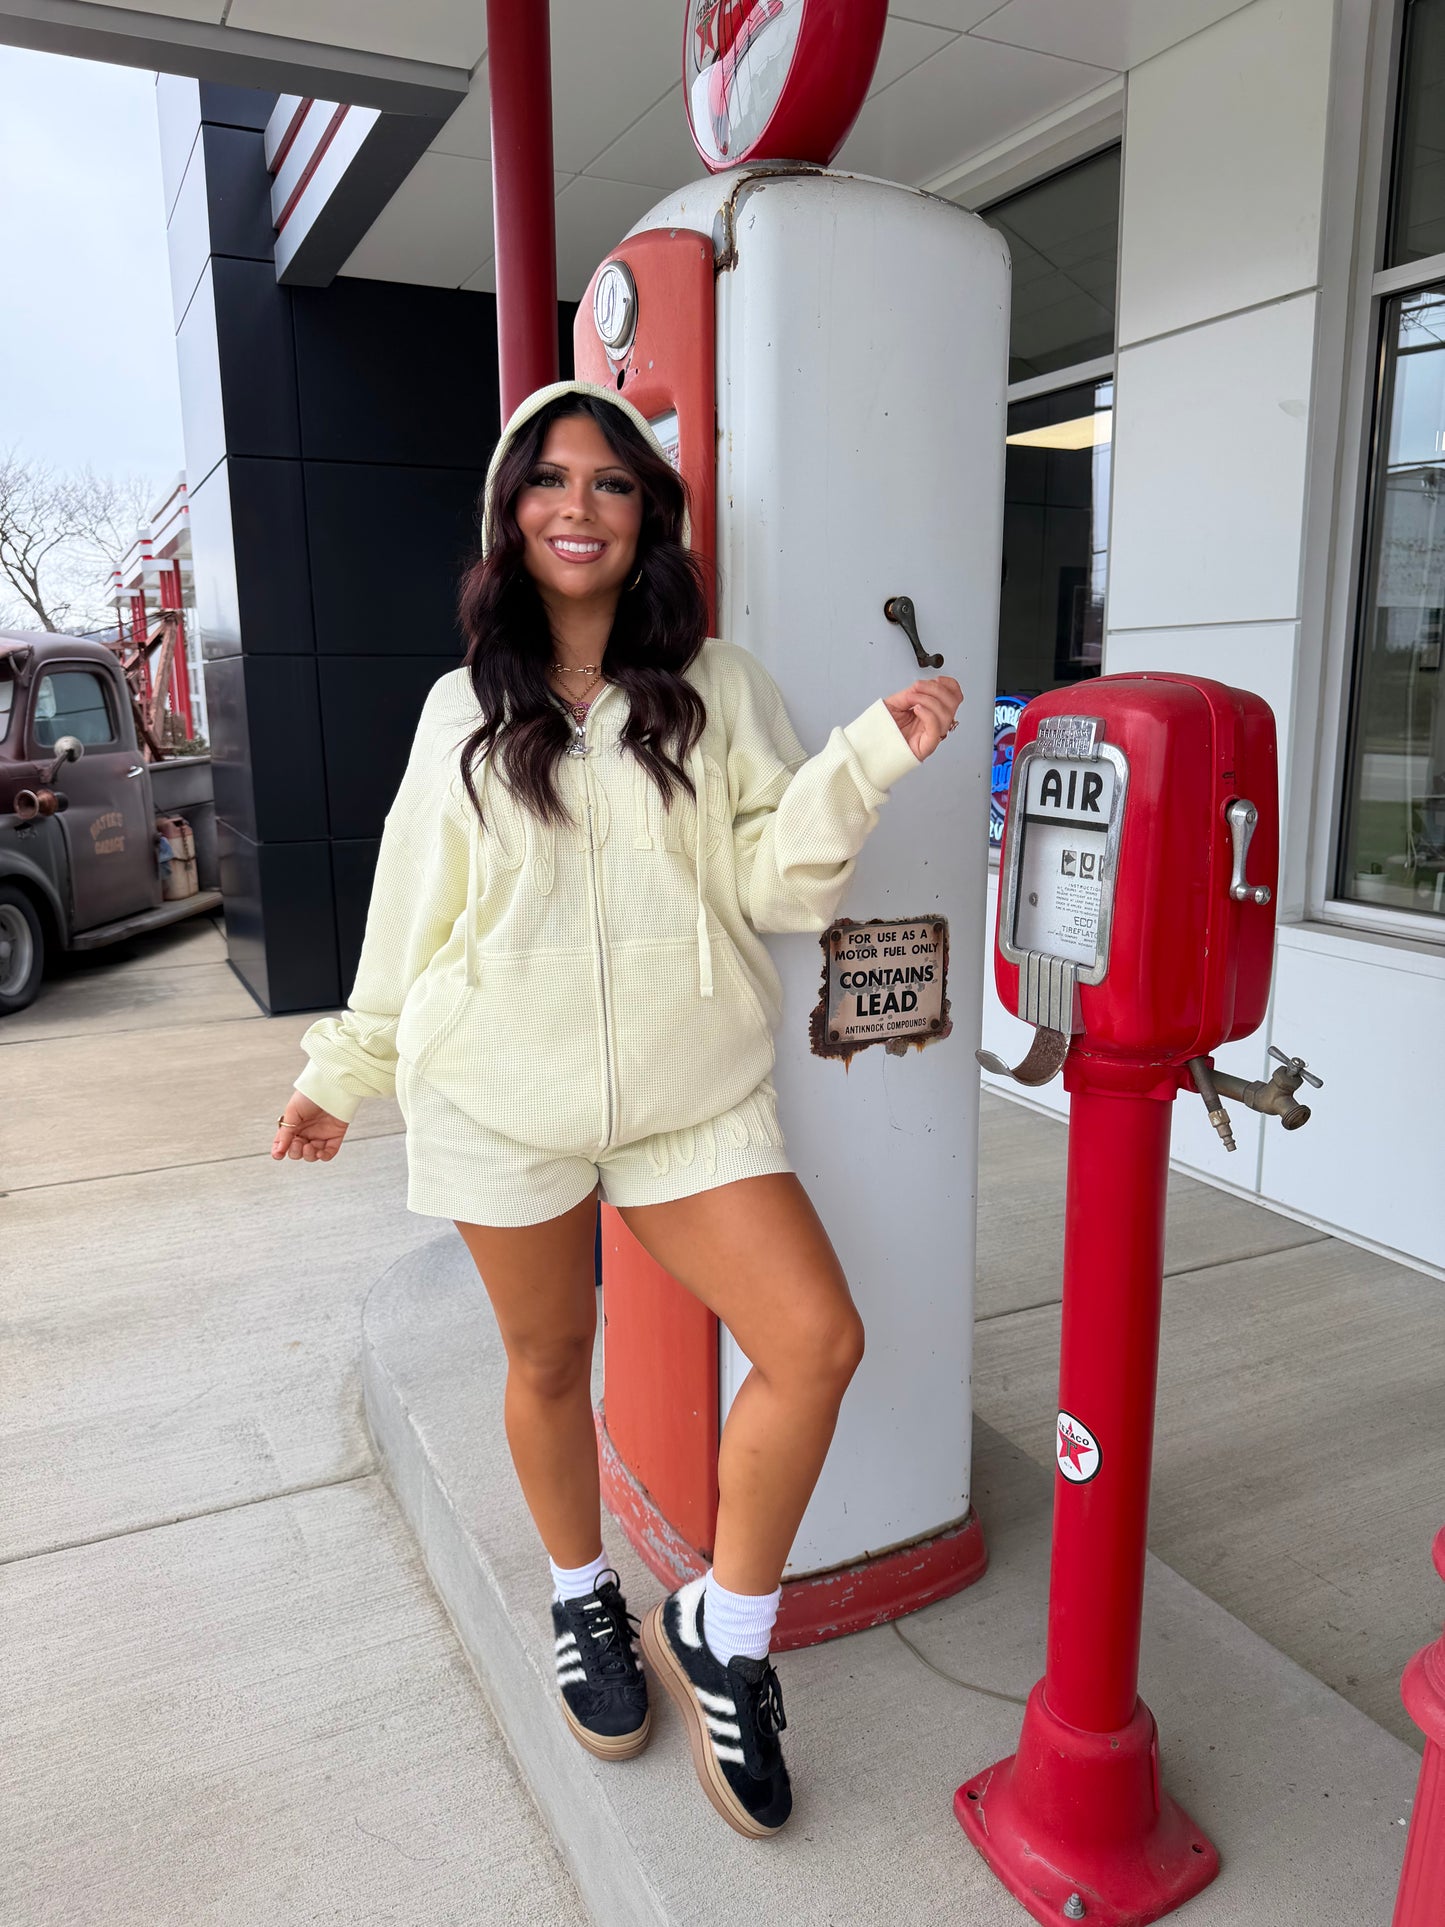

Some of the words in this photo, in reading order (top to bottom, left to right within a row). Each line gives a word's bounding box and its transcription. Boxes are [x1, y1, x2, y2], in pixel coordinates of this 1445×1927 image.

[697, 0, 717, 23] TEXAC
[1040, 768, 1103, 813] AIR
[1069, 883, 1102, 892] INSTRUCTIO
[1074, 916, 1093, 928] ECO
[849, 934, 871, 945] FOR
[877, 931, 897, 943] USE
[902, 930, 915, 941] AS
[920, 929, 928, 939] A
[835, 948, 878, 962] MOTOR
[884, 946, 907, 957] FUEL
[911, 942, 939, 955] ONLY
[839, 965, 934, 989] CONTAINS
[856, 990, 918, 1017] LEAD
[845, 1021, 885, 1035] ANTIKNOCK
[886, 1017, 927, 1031] COMPOUNDS
